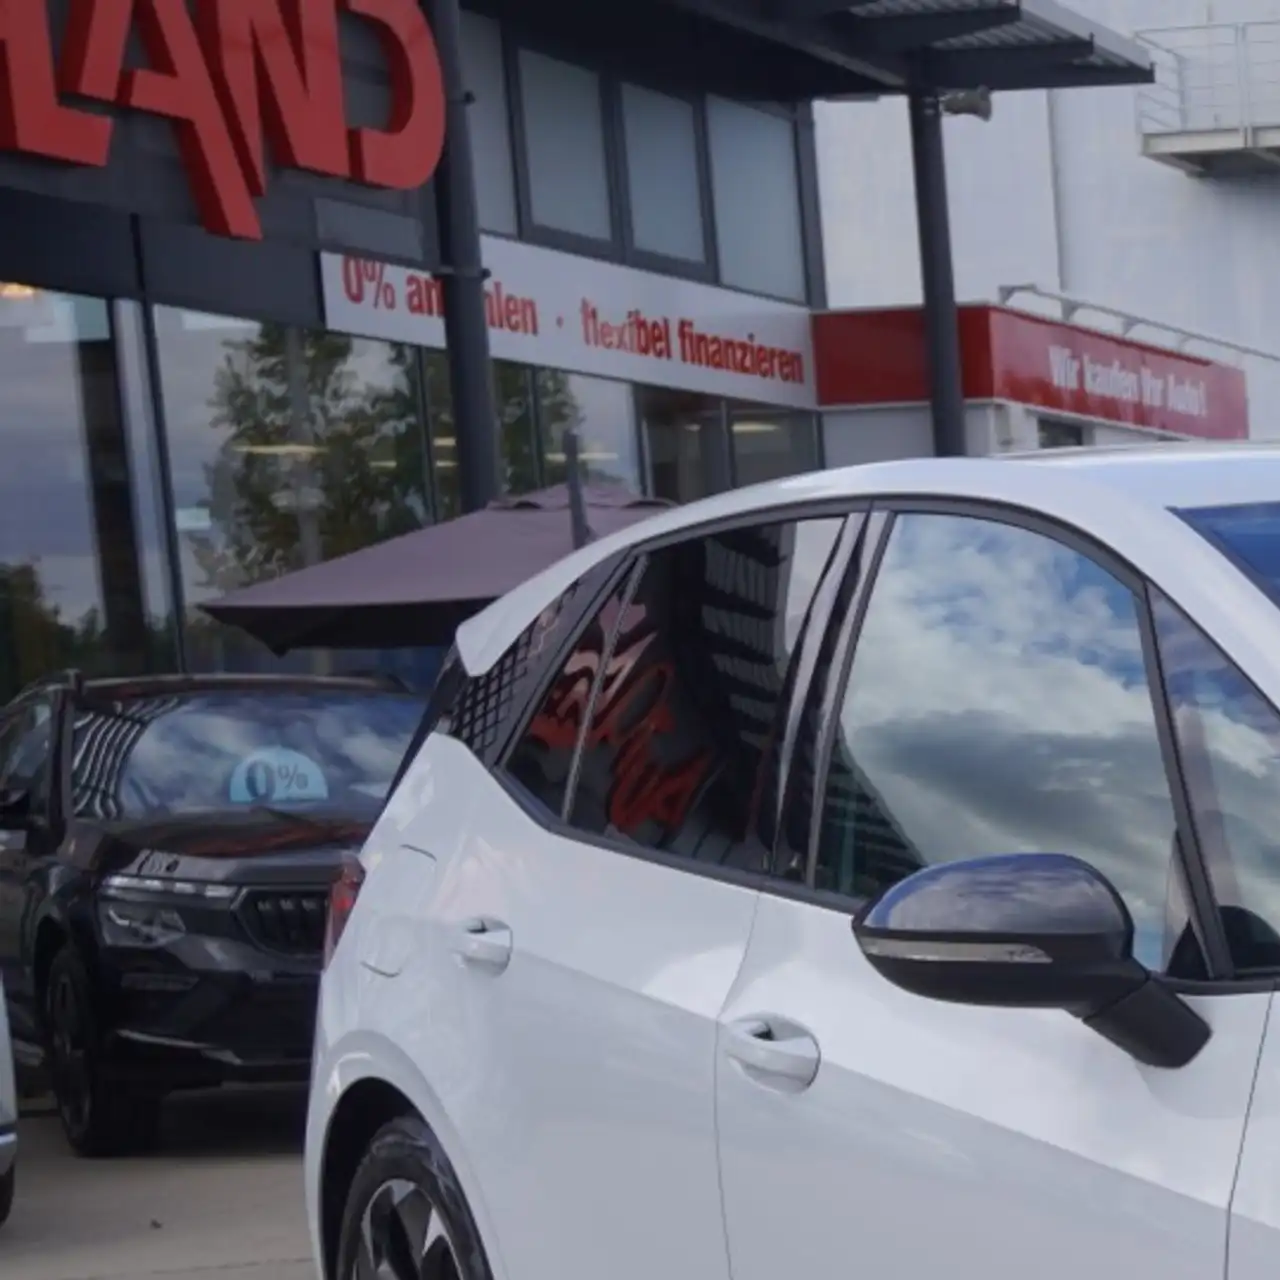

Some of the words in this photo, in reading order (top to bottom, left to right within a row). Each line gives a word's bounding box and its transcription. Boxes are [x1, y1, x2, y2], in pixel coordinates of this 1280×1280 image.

[343, 254, 396, 309] 0%
[678, 318, 804, 384] finanzieren
[245, 760, 309, 802] 0%
